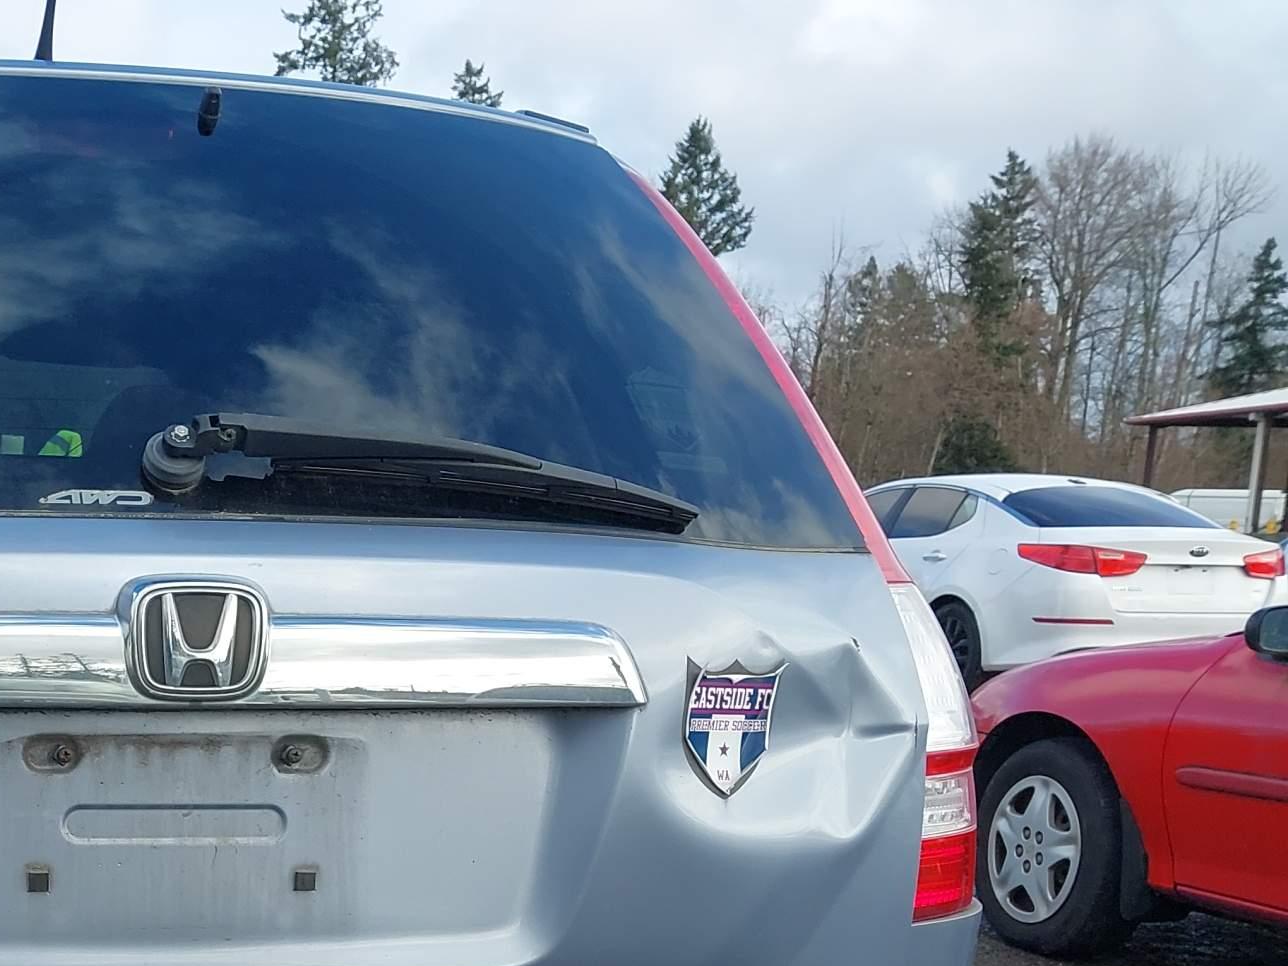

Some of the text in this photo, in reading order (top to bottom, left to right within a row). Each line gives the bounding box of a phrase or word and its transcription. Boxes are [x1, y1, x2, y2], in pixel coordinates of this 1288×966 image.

[691, 687, 773, 710] EASTSIDE FC
[691, 720, 767, 731] PREMIER SOCCER
[717, 770, 730, 781] WA
